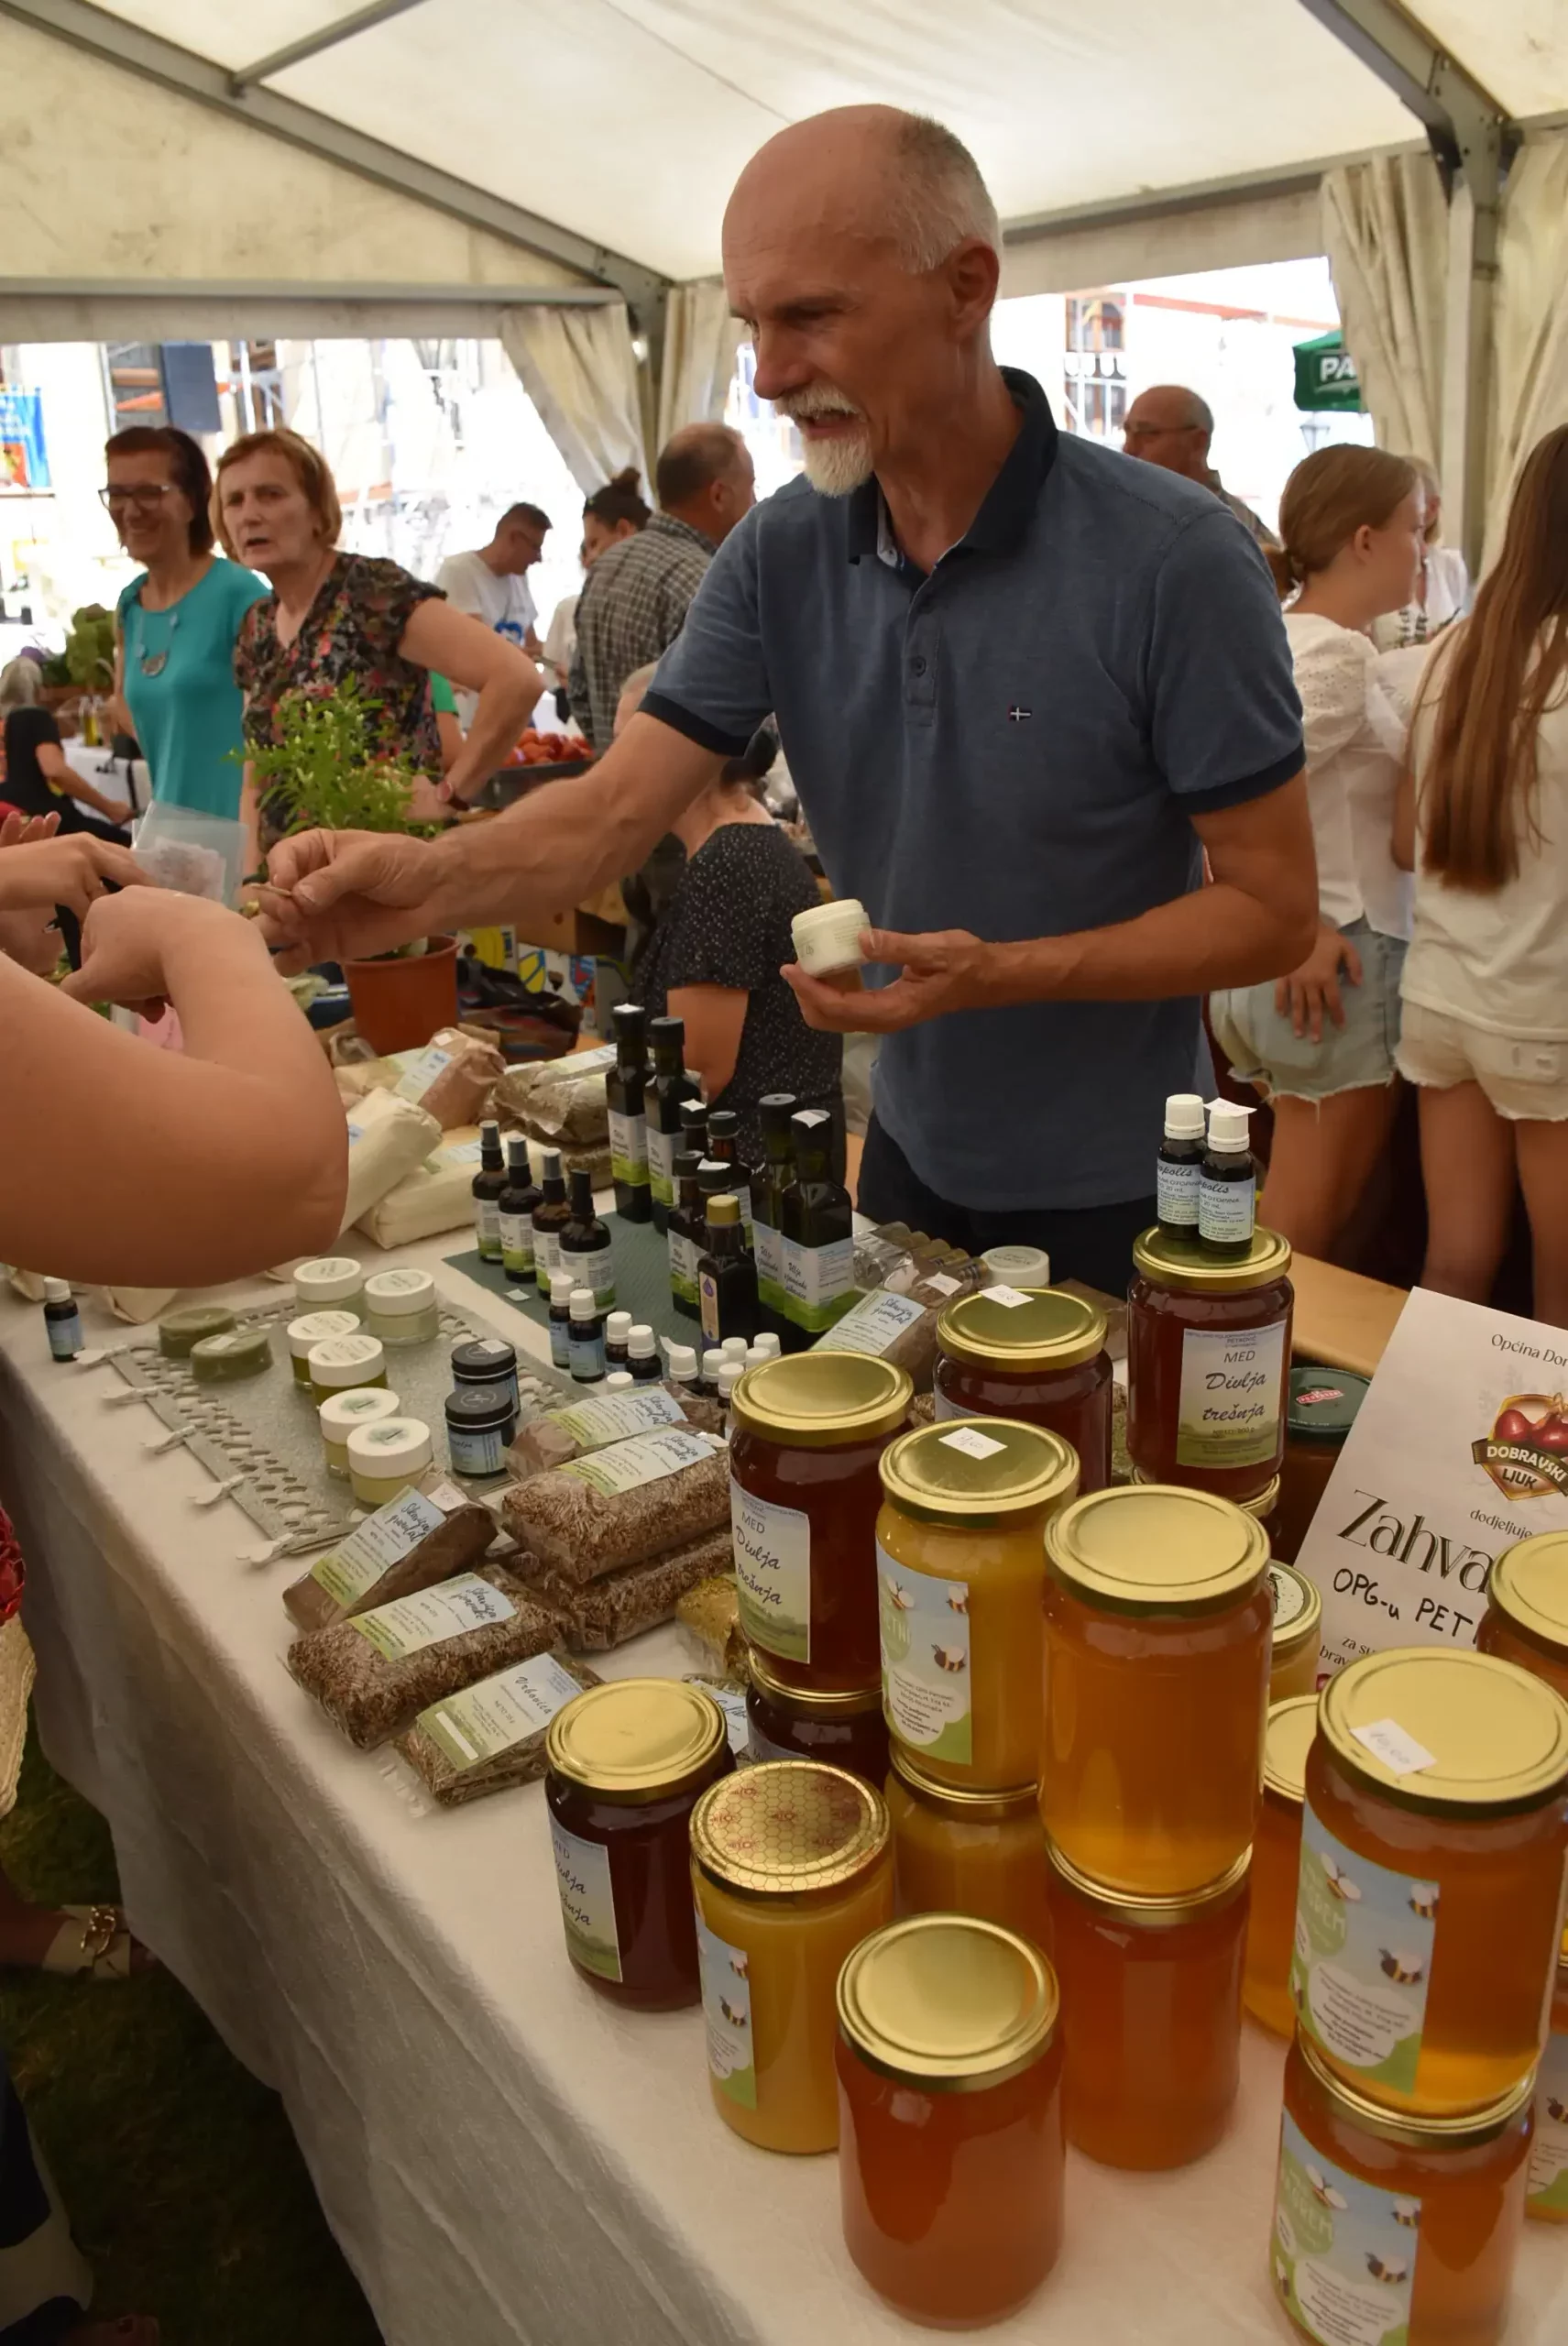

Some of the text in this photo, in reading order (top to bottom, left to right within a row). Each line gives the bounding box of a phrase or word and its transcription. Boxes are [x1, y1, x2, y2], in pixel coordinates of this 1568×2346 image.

[1223, 1350, 1255, 1364] MED
[1491, 1333, 1541, 1358] Općina
[1205, 1371, 1266, 1393] Divlja
[1201, 1403, 1266, 1424] trešnja
[1486, 1445, 1568, 1483] DOBRAVSKI
[1502, 1468, 1538, 1489] LJUK
[741, 1511, 765, 1534] MED
[1470, 1509, 1533, 1540] dodjeljuje
[736, 1525, 781, 1570] Divlja
[738, 1563, 783, 1605] trešnja
[1333, 1568, 1399, 1620] OPG-u
[1342, 1637, 1357, 1650] za
